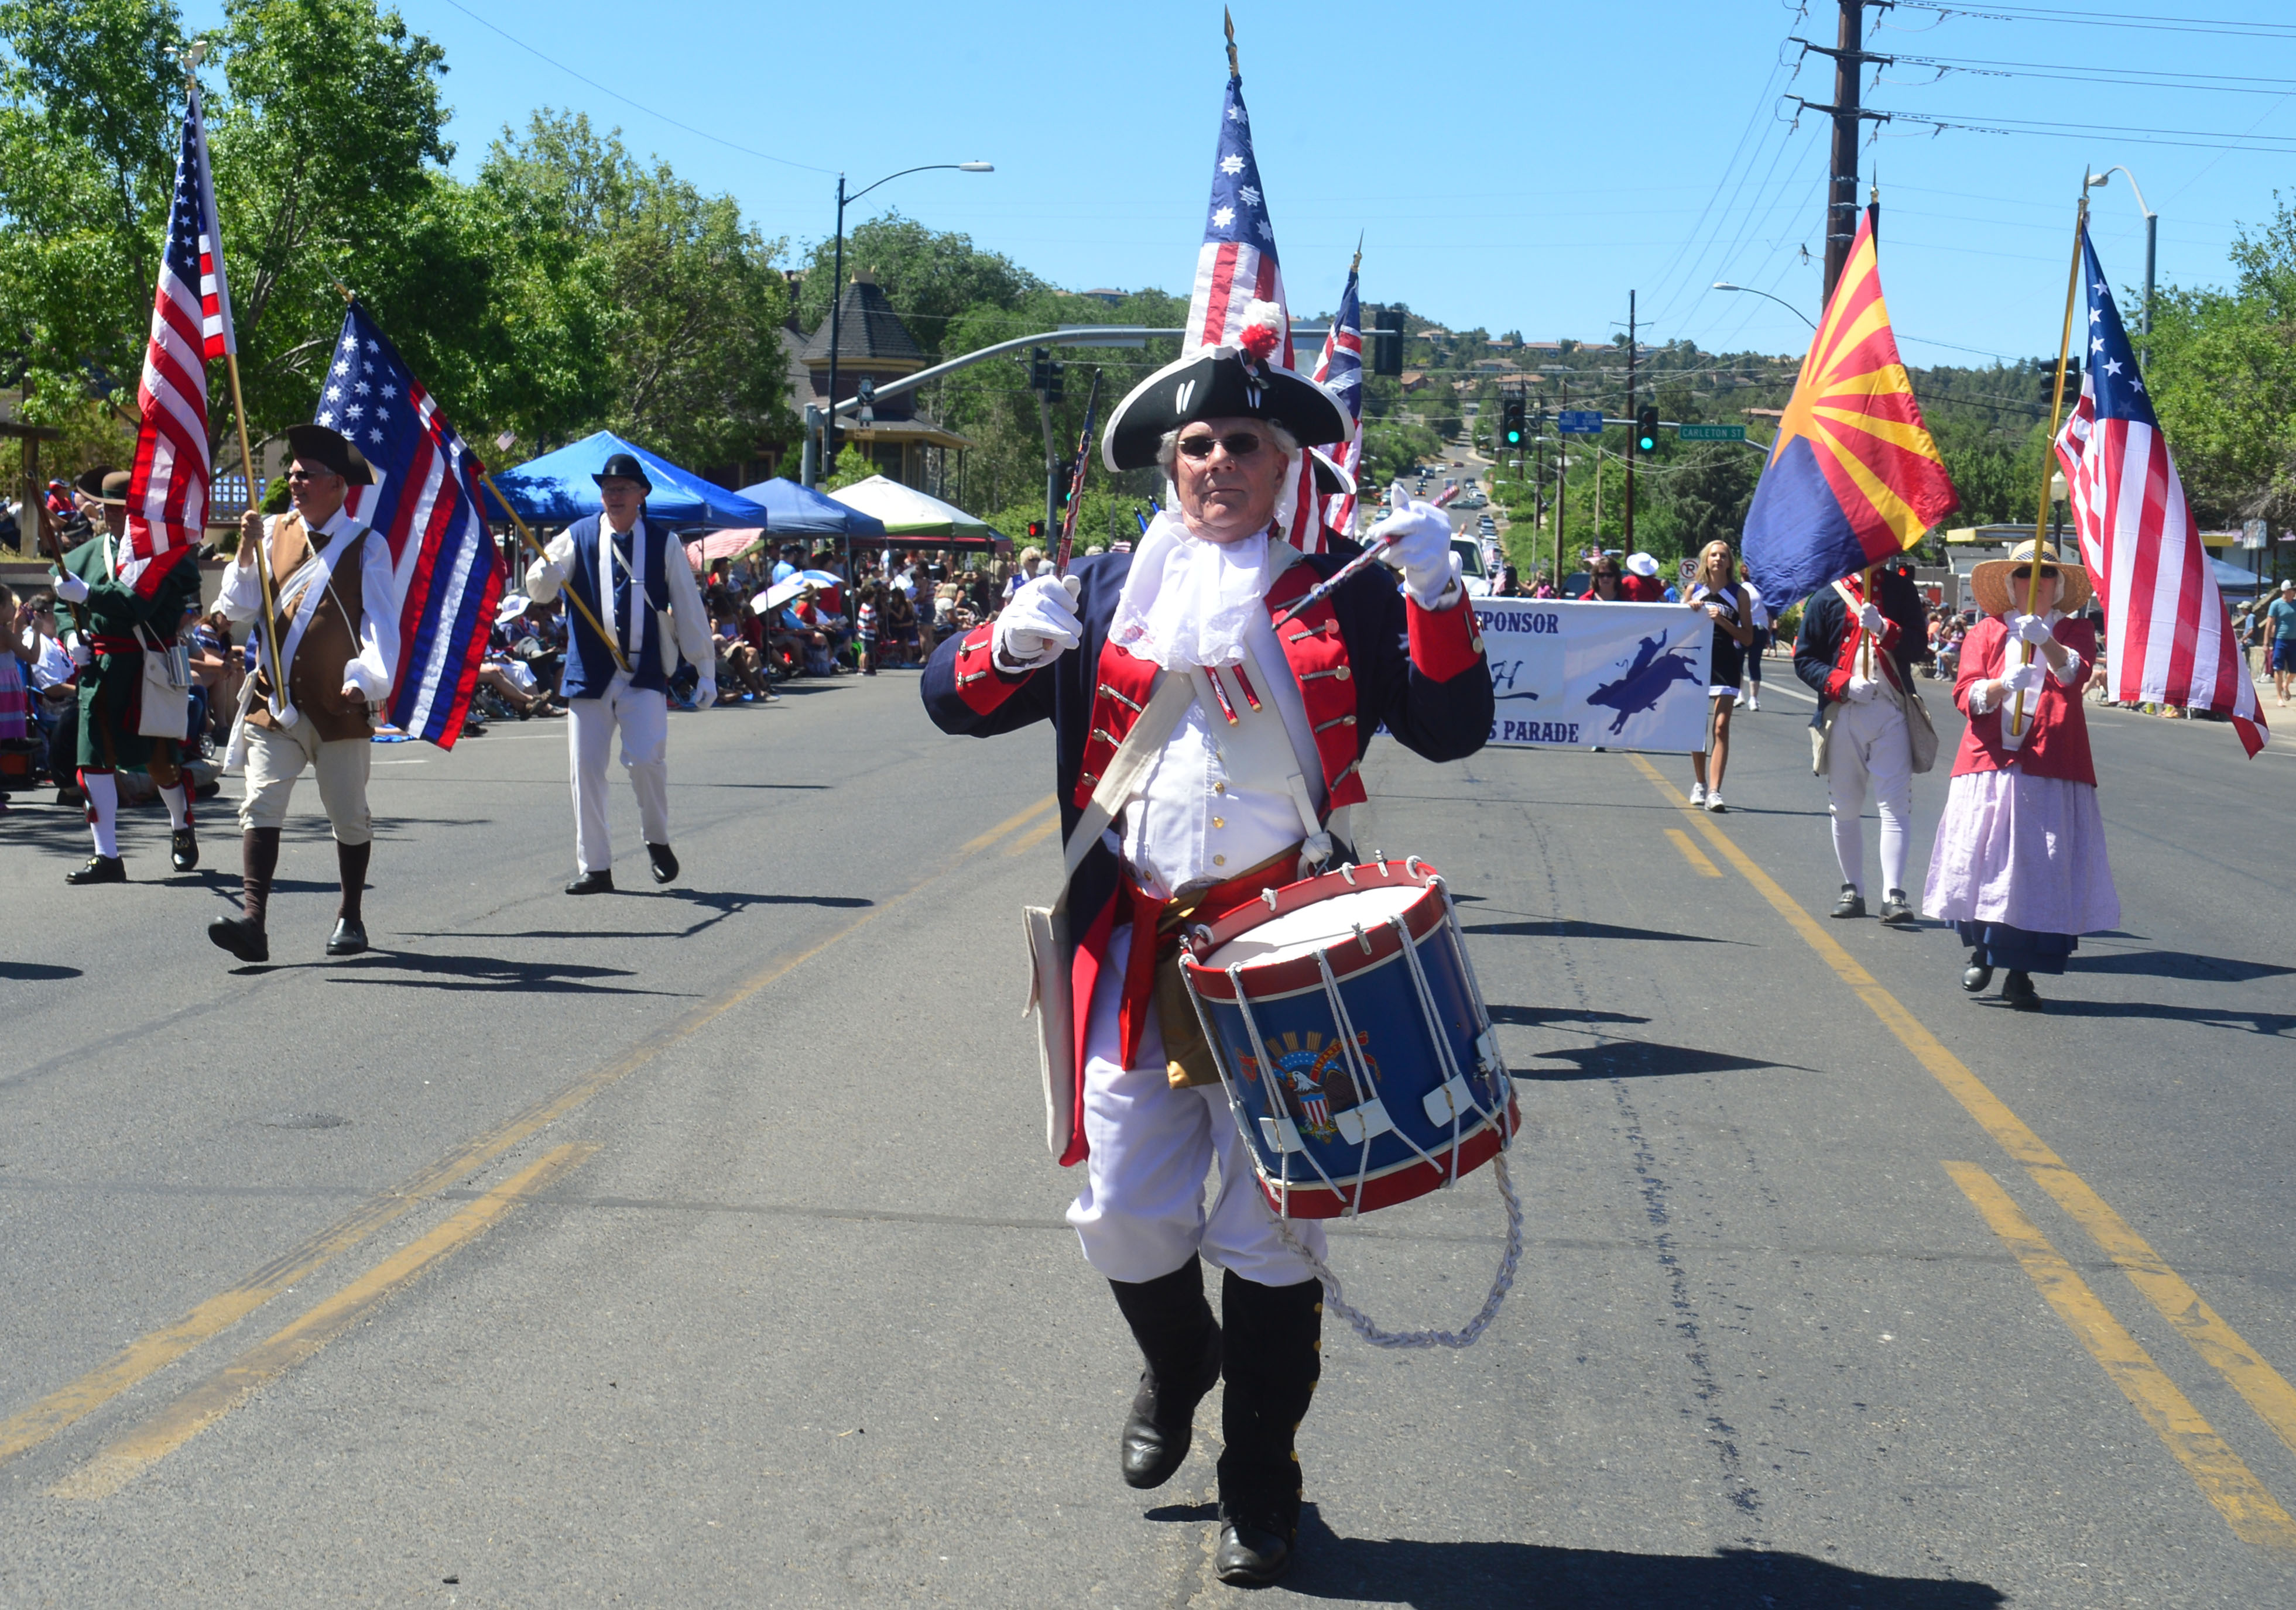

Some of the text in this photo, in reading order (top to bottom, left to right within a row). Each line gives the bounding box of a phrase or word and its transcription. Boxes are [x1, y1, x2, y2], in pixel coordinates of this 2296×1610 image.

[1682, 428, 1741, 437] CARLETON ST
[1503, 720, 1579, 743] PARADE
